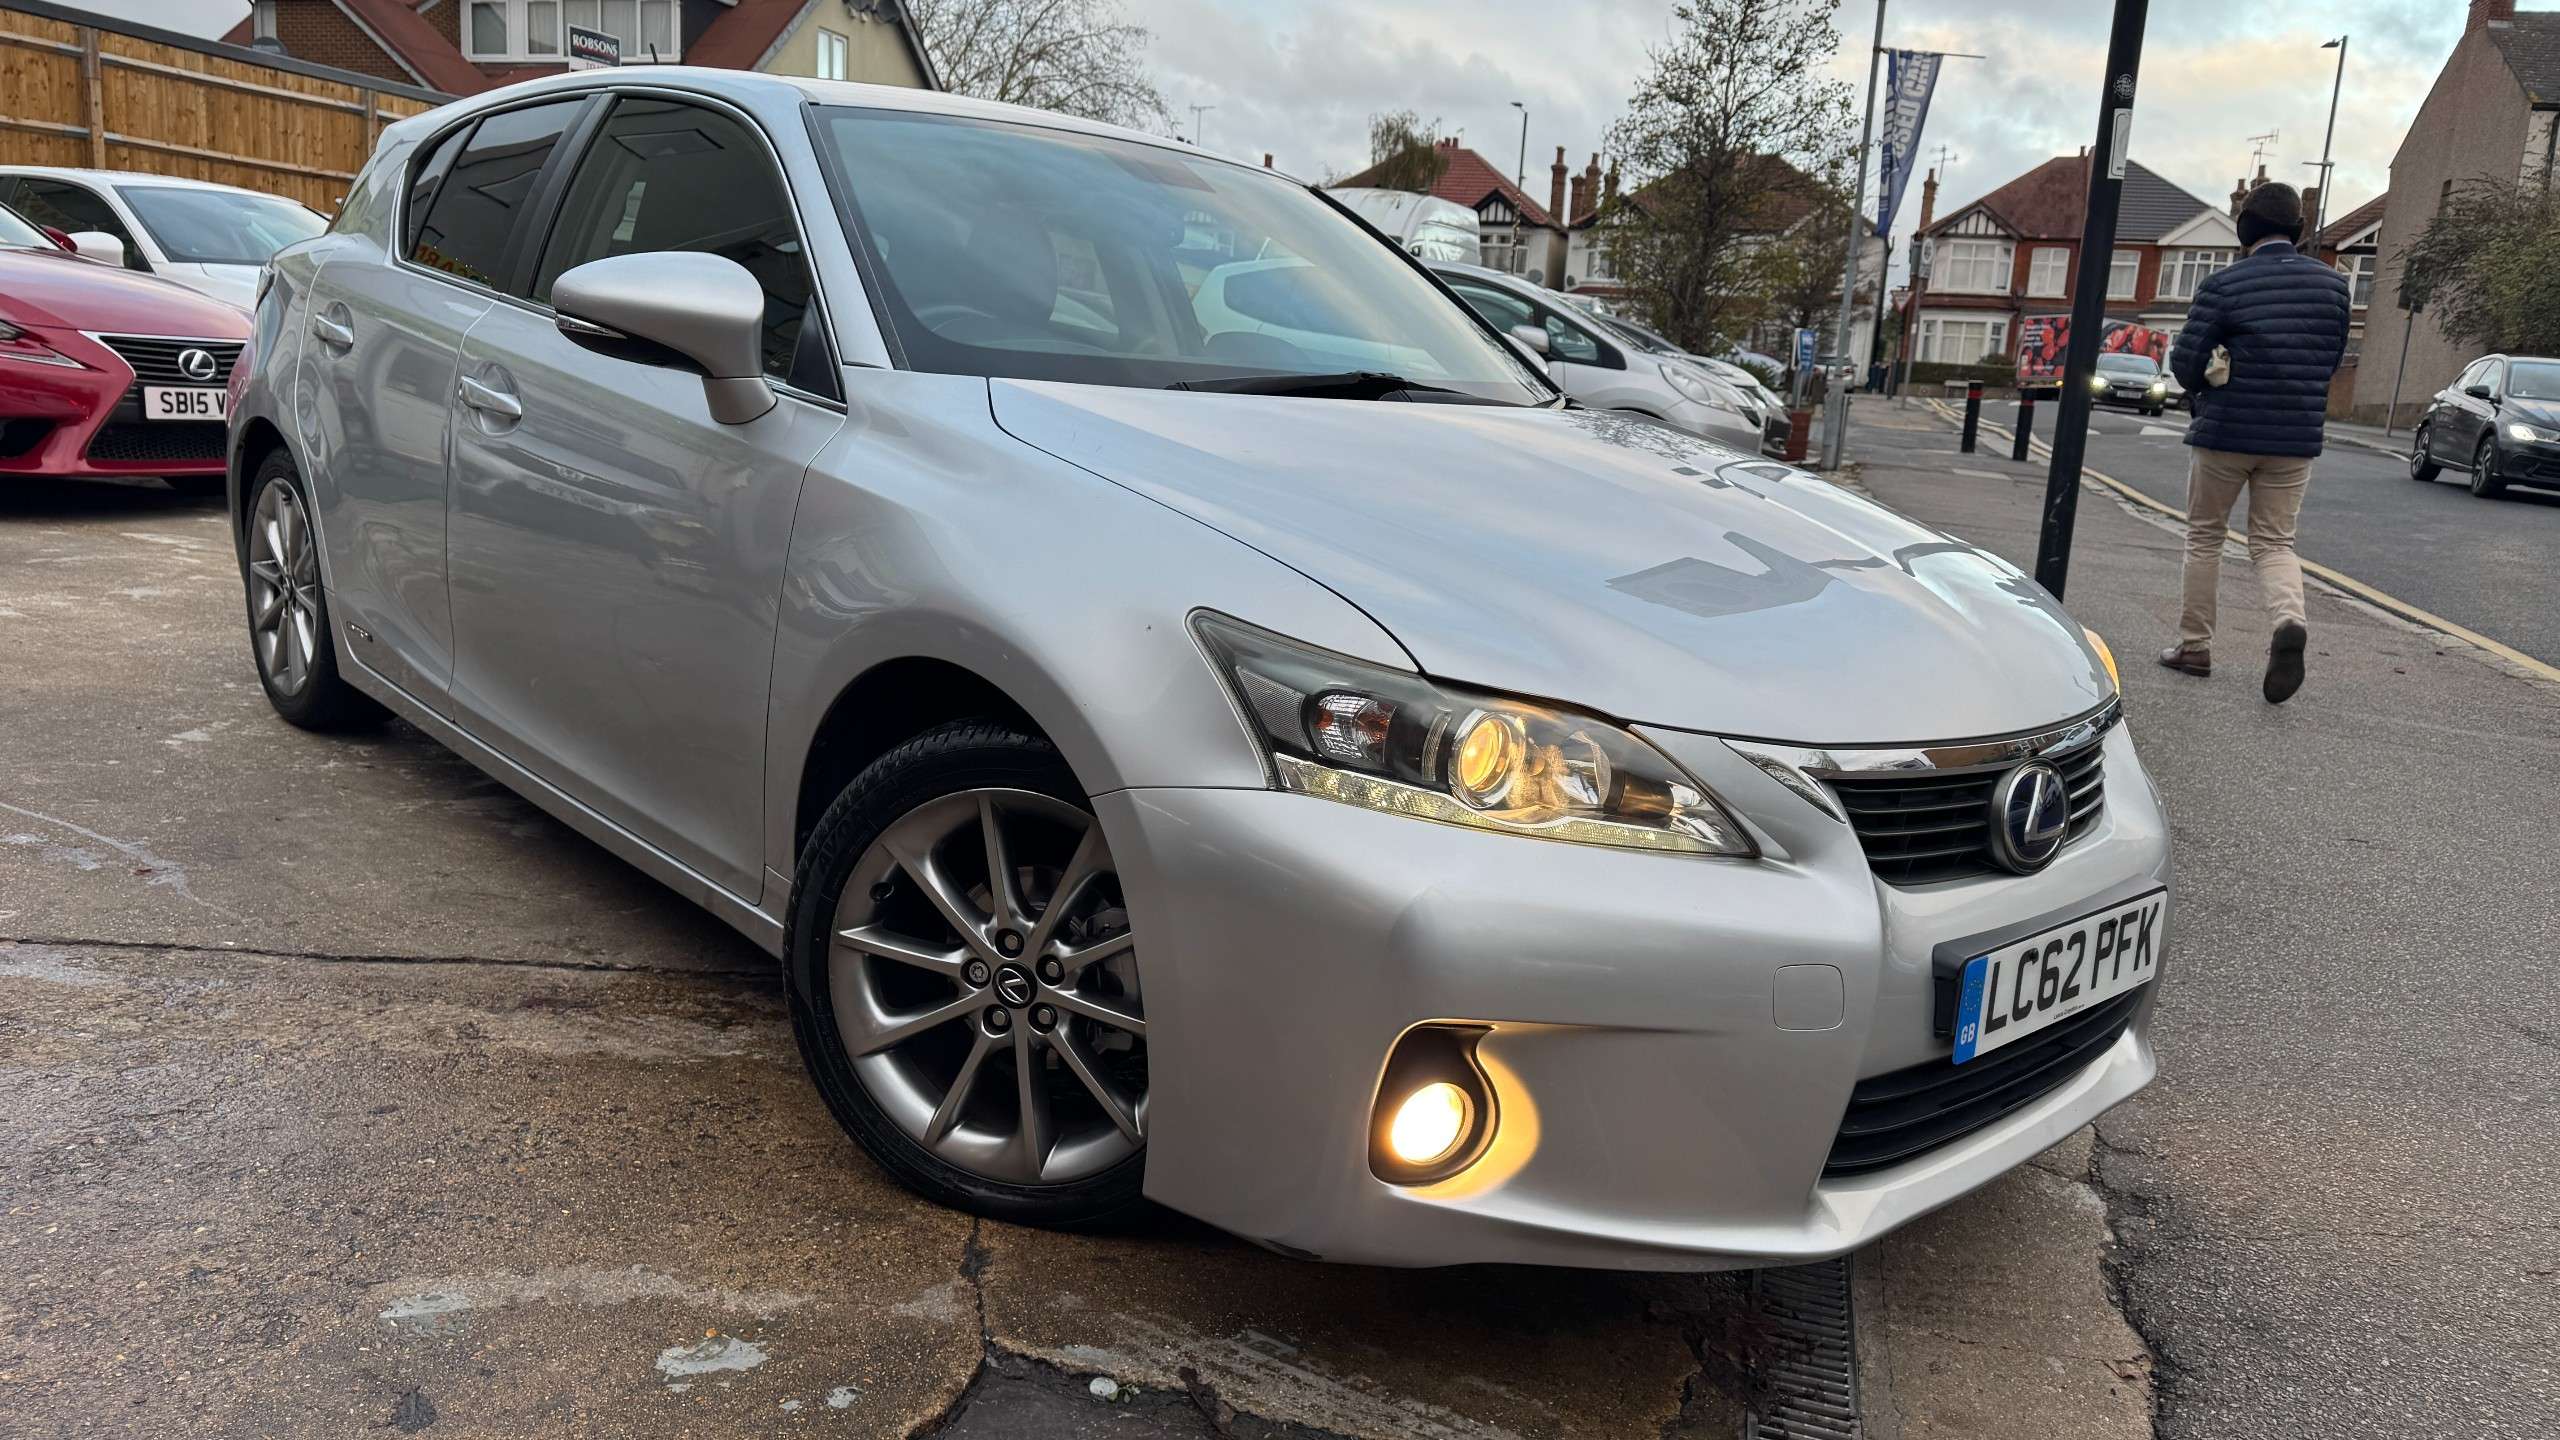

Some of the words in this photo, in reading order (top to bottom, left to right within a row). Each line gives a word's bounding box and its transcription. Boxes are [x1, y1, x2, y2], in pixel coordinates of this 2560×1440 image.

[572, 34, 618, 56] ROBSONS
[160, 391, 209, 414] SB15
[1984, 929, 2087, 1036] LC62
[2090, 901, 2160, 990] PFK
[1960, 1022, 1976, 1046] GB
